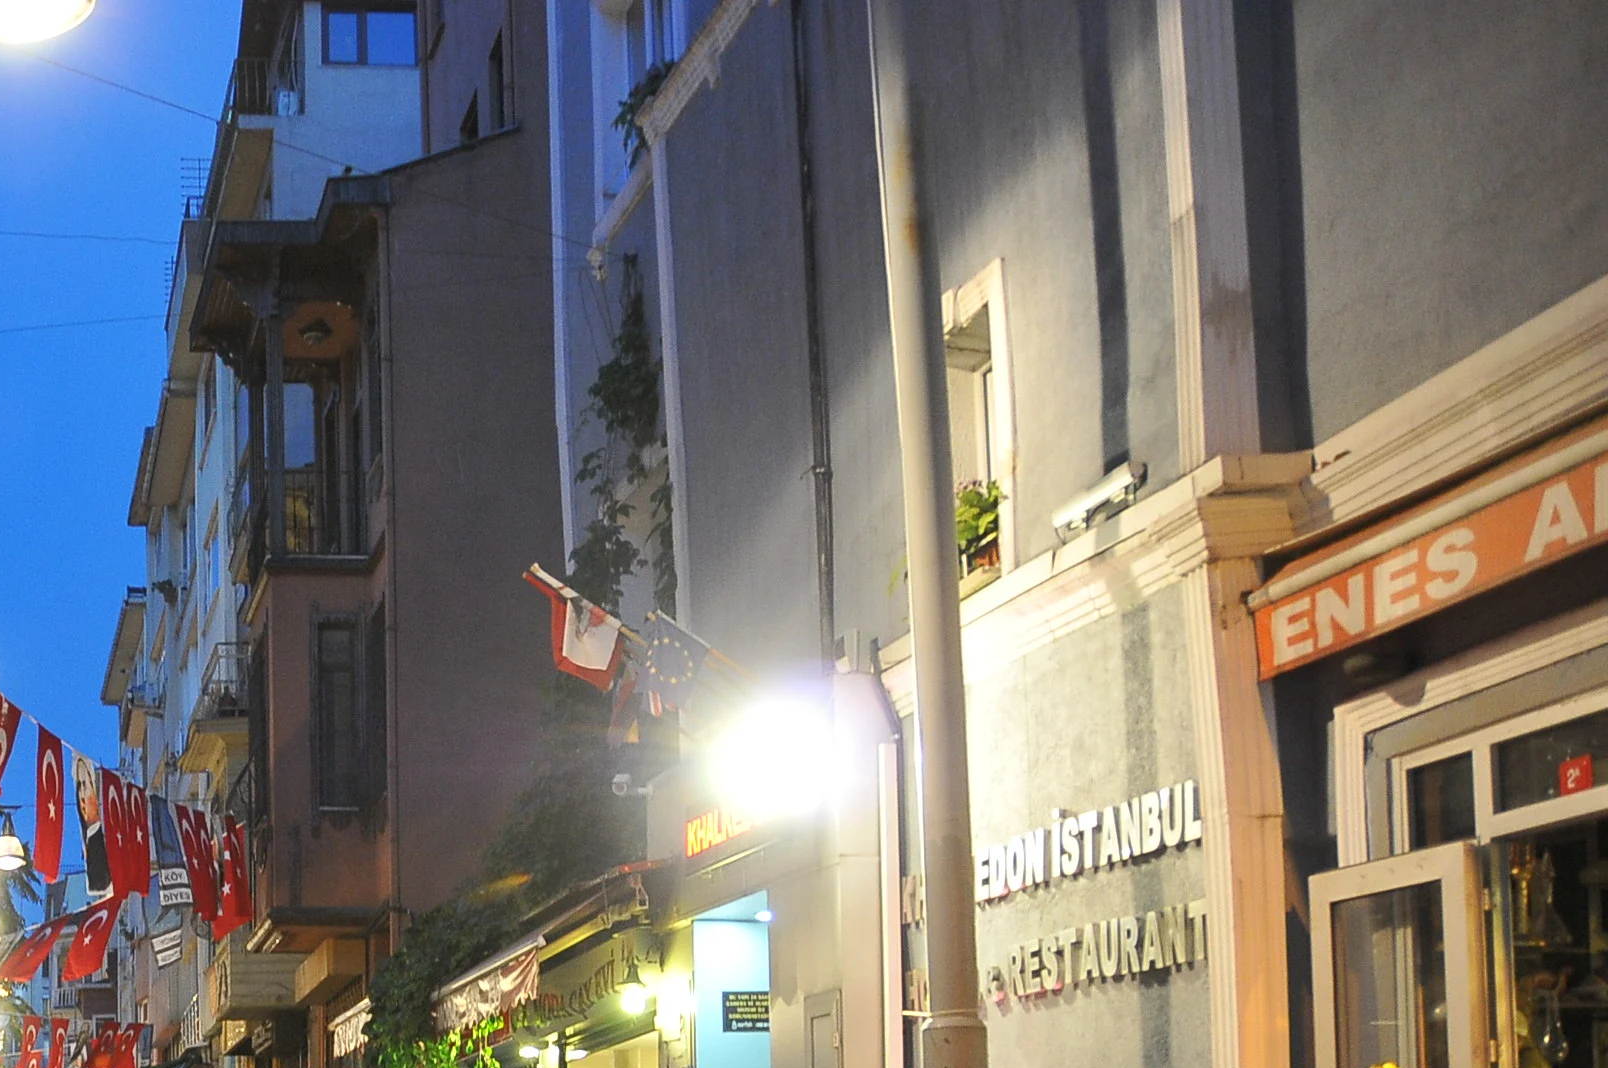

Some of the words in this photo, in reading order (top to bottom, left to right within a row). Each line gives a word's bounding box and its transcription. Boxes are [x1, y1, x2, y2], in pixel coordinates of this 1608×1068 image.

[1270, 526, 1478, 667] ENES
[1051, 779, 1203, 878] İSTANBUL
[1008, 898, 1208, 997] RESTAURANT
